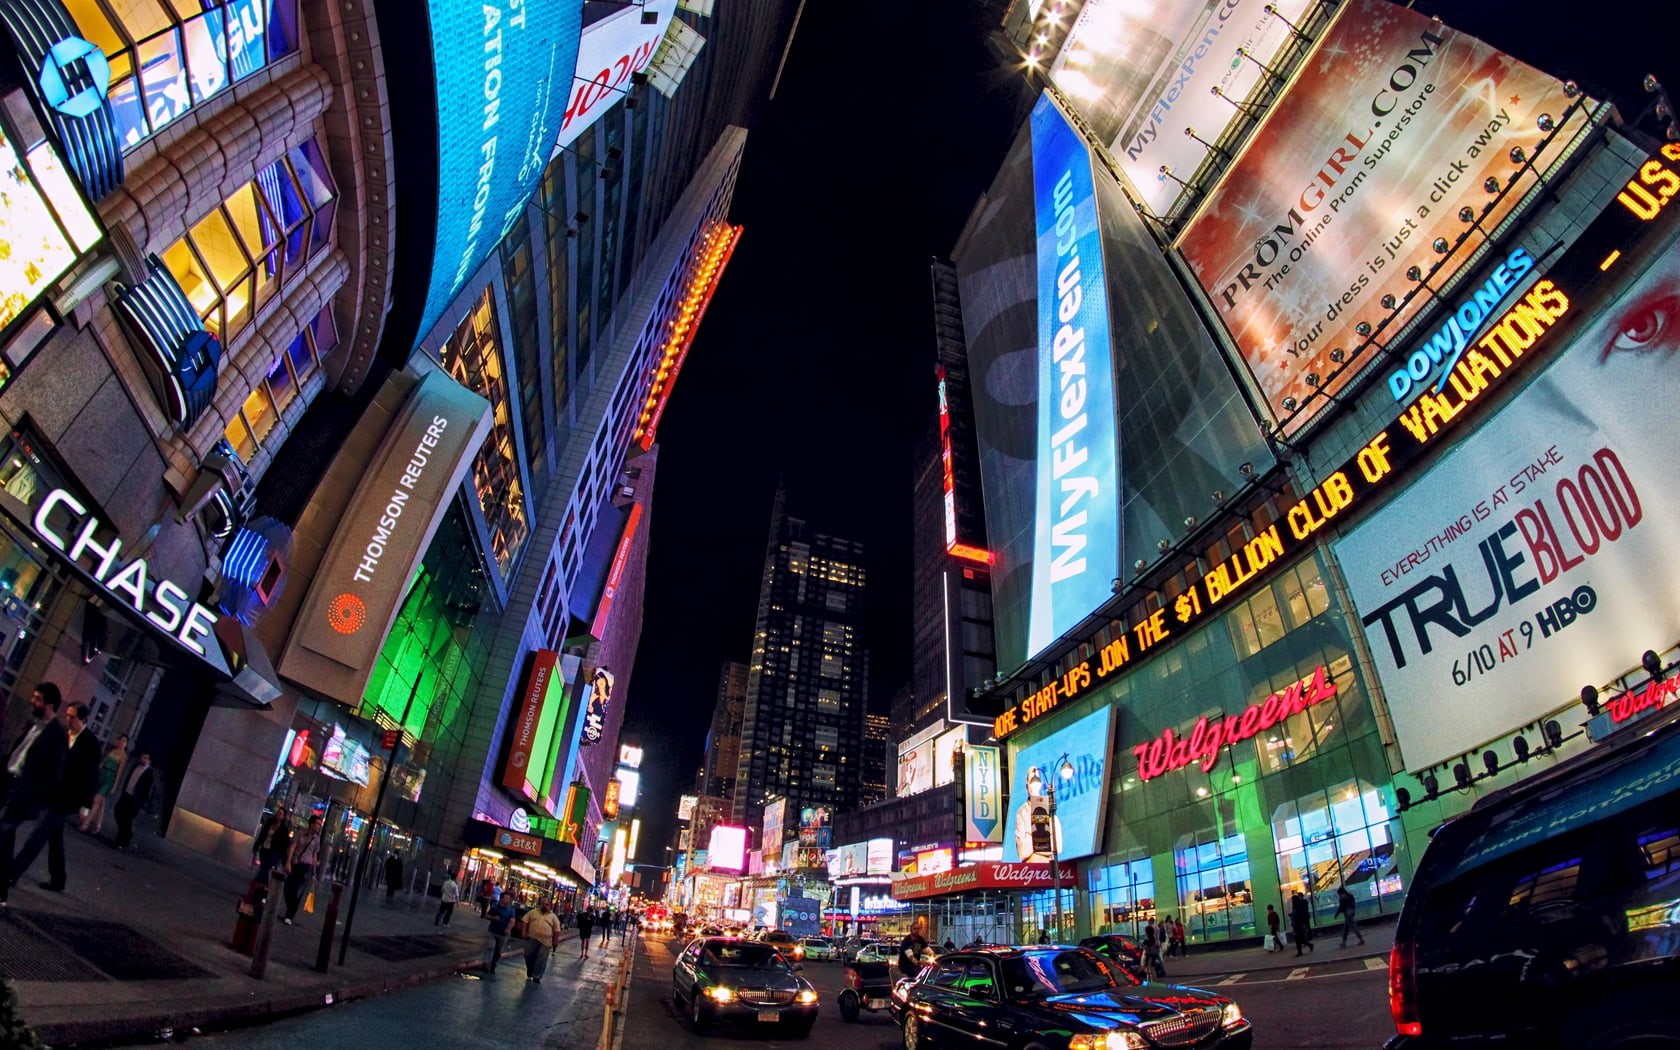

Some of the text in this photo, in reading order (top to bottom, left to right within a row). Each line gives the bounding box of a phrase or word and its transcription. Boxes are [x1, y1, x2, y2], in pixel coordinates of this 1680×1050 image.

[467, 136, 499, 240] FROM
[1222, 29, 1445, 312] PROMGIRL.COM
[1262, 82, 1436, 293] The Online Prom Superstore
[1286, 106, 1512, 362] Your dress is just a click away
[1050, 168, 1100, 584] MyFlexPen.com
[353, 415, 448, 584] THOMSON REUTERS
[1021, 662, 1091, 724] START-UPS
[1097, 638, 1129, 677] JOIN
[1134, 607, 1170, 653] THE
[1174, 589, 1202, 624] $1
[1204, 530, 1285, 605] BILLION
[1287, 470, 1356, 541] CLUB
[1357, 432, 1392, 484] OF
[1398, 279, 1570, 445] VALUATIONS
[1362, 447, 1644, 670] TRUE BLOOD
[1380, 444, 1564, 586] EVERYTHING IS AT STAKE
[33, 487, 219, 656] CHASE
[1451, 584, 1598, 687] 6/10 AT 9 HBO
[519, 666, 547, 747] THOMSON REUTERS
[1132, 665, 1338, 782] Walgreens
[512, 838, 538, 852] at&t
[978, 750, 991, 819] NYPD
[894, 880, 927, 898] Walgreens
[934, 869, 977, 890] Walgreens
